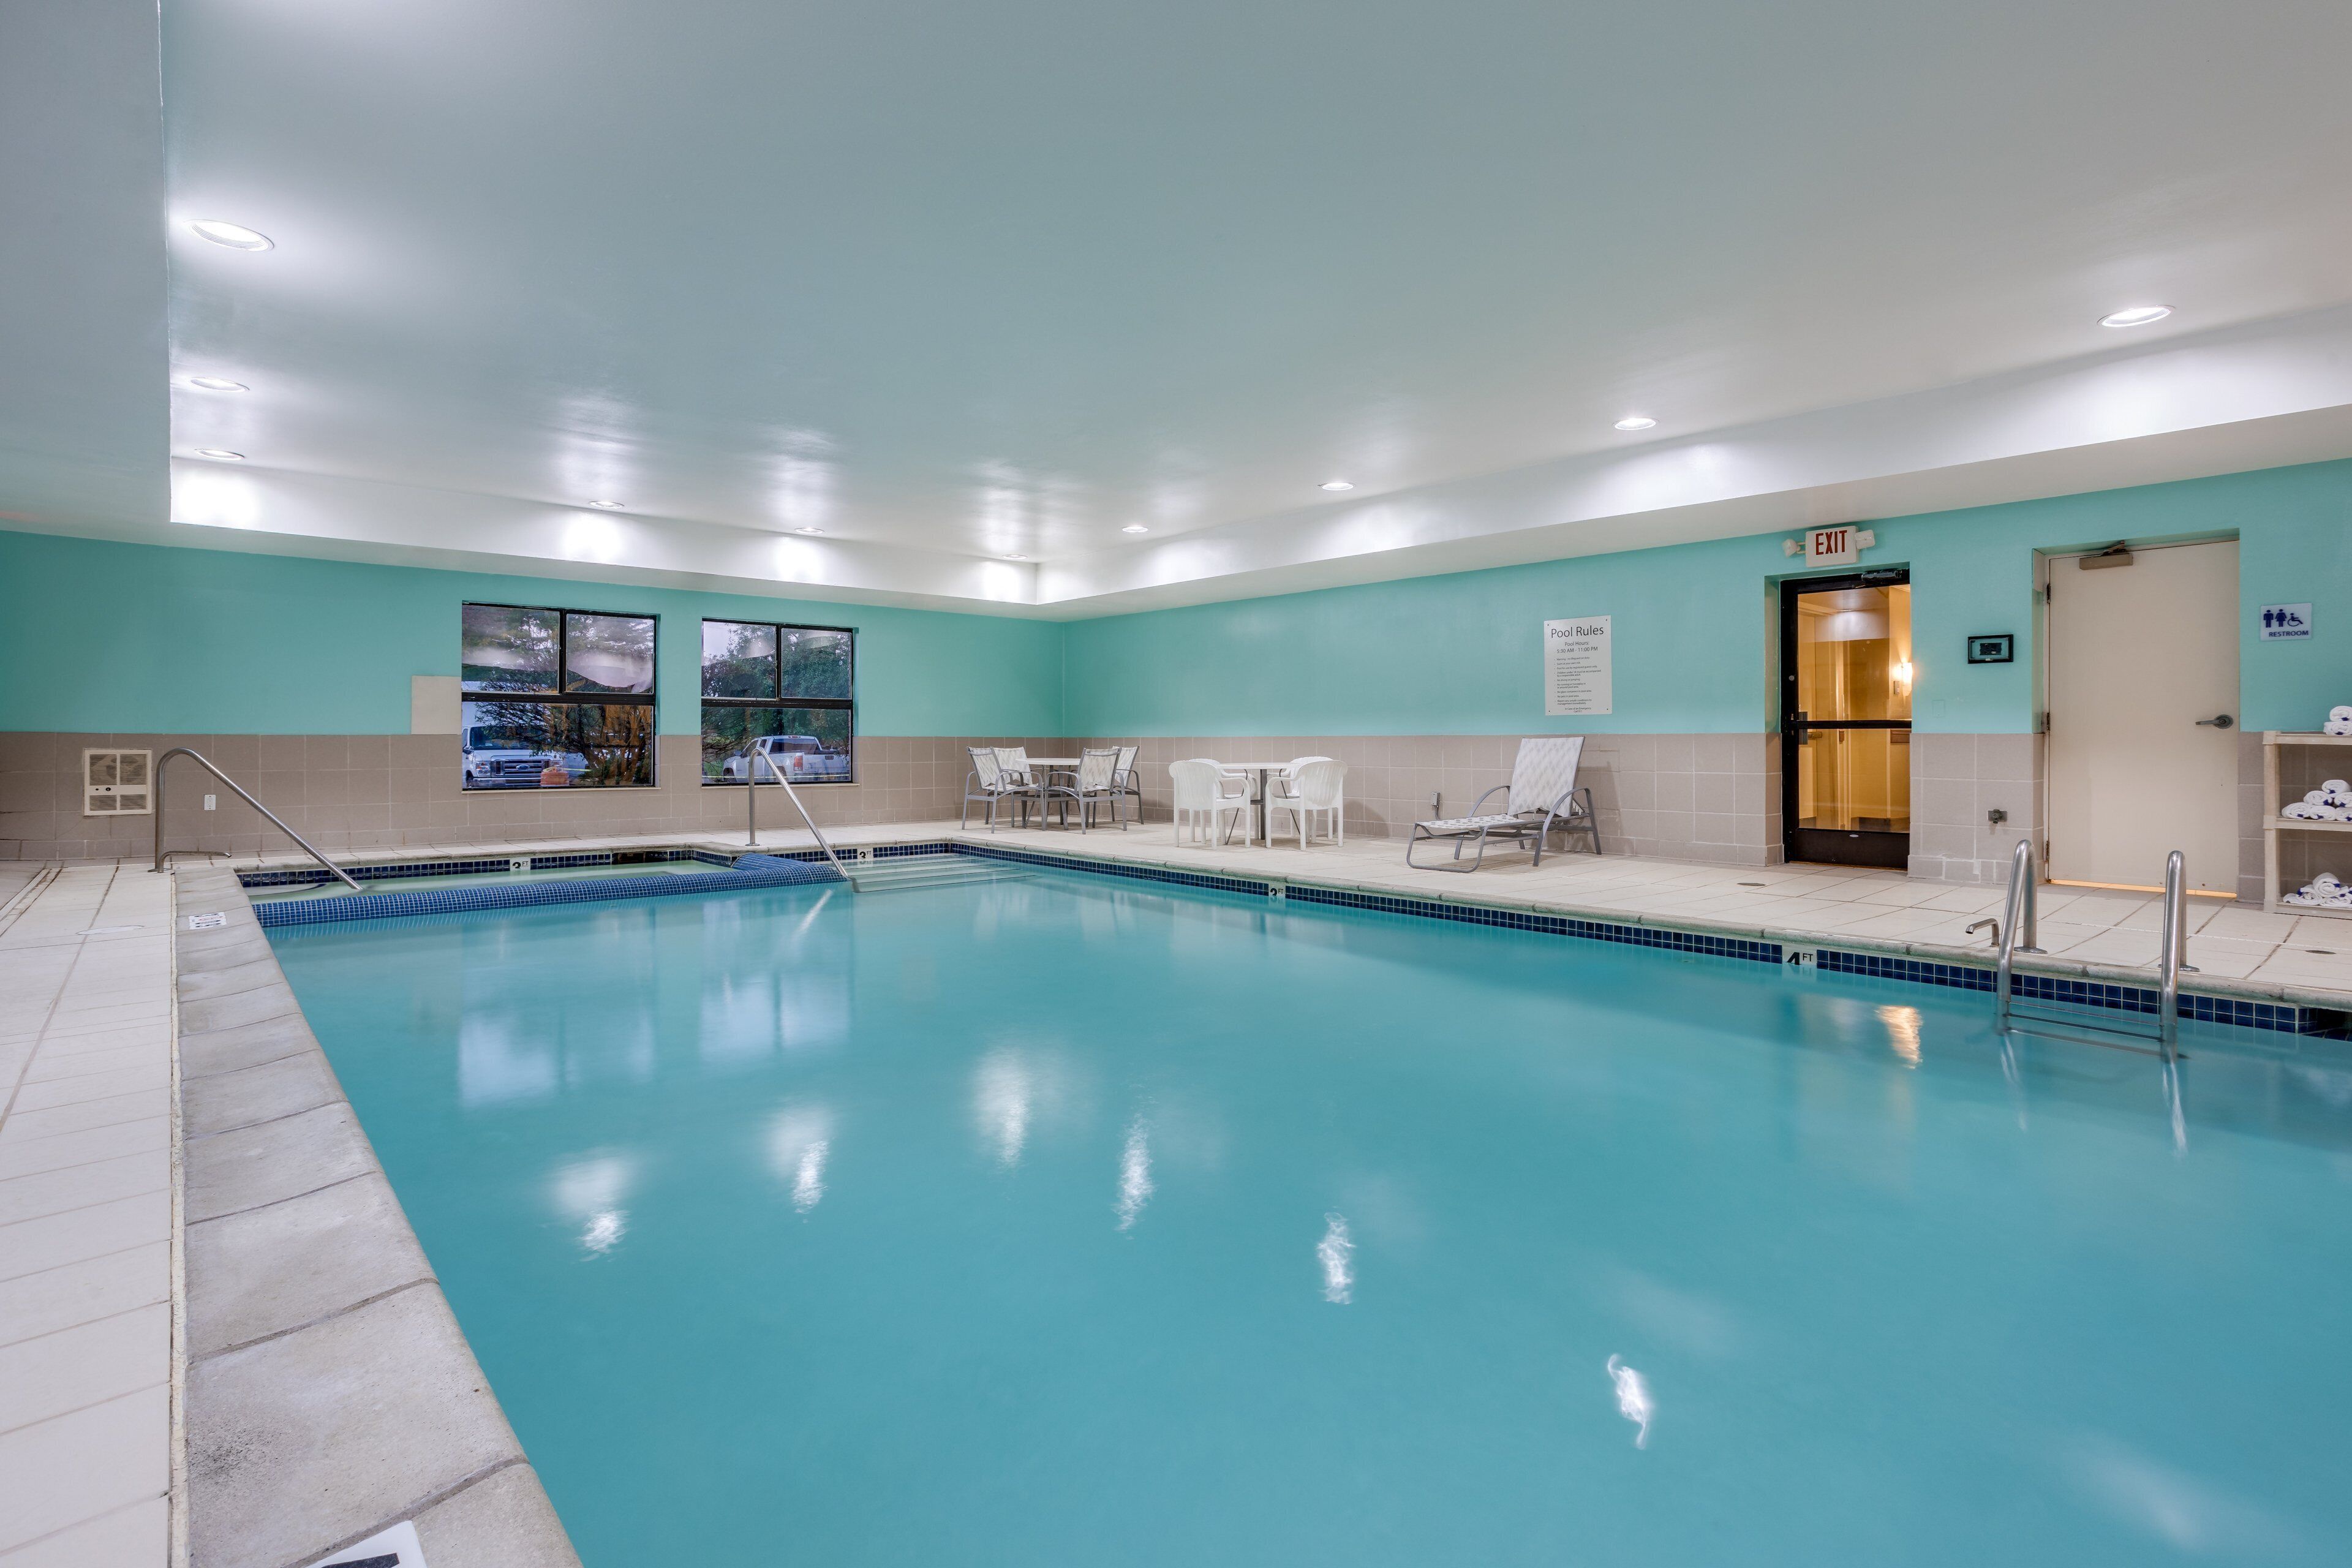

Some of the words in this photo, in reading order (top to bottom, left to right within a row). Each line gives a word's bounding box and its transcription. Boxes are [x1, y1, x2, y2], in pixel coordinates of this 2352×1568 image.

[1815, 530, 1847, 556] EXIT
[1551, 627, 1573, 638] Pool
[1576, 625, 1604, 636] Rules
[1803, 953, 1814, 962] FT
